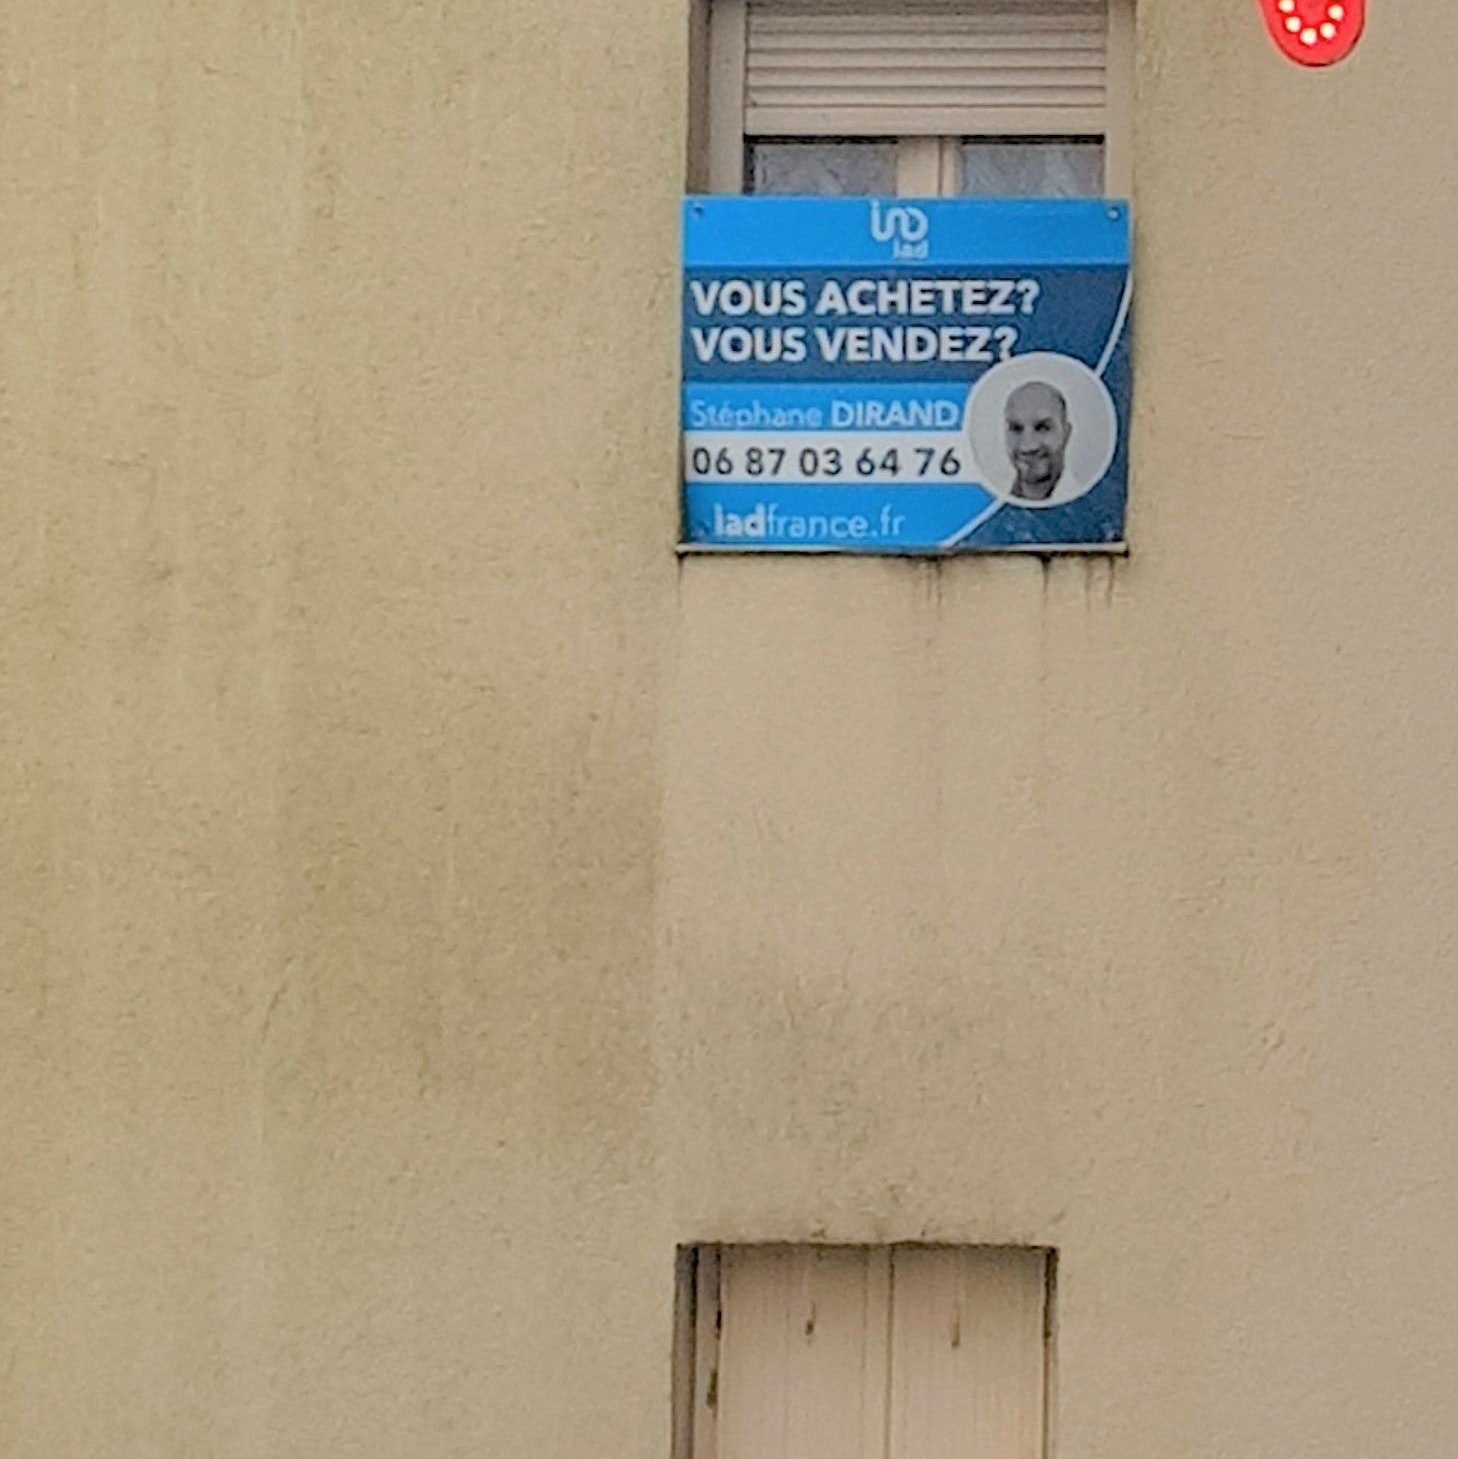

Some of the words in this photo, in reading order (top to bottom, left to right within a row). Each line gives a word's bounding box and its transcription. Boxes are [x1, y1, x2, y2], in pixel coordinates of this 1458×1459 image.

[689, 280, 806, 316] VOUS
[815, 279, 1040, 316] ACHETEZ?
[689, 327, 806, 363] VOUS
[815, 326, 1018, 363] VENDEZ?
[689, 399, 823, 429] Stéphane
[831, 400, 959, 428] DIRAND
[693, 447, 733, 476] 06
[746, 447, 786, 476] 87
[800, 447, 842, 477] 03
[856, 447, 900, 477] 64
[914, 447, 961, 477] 76
